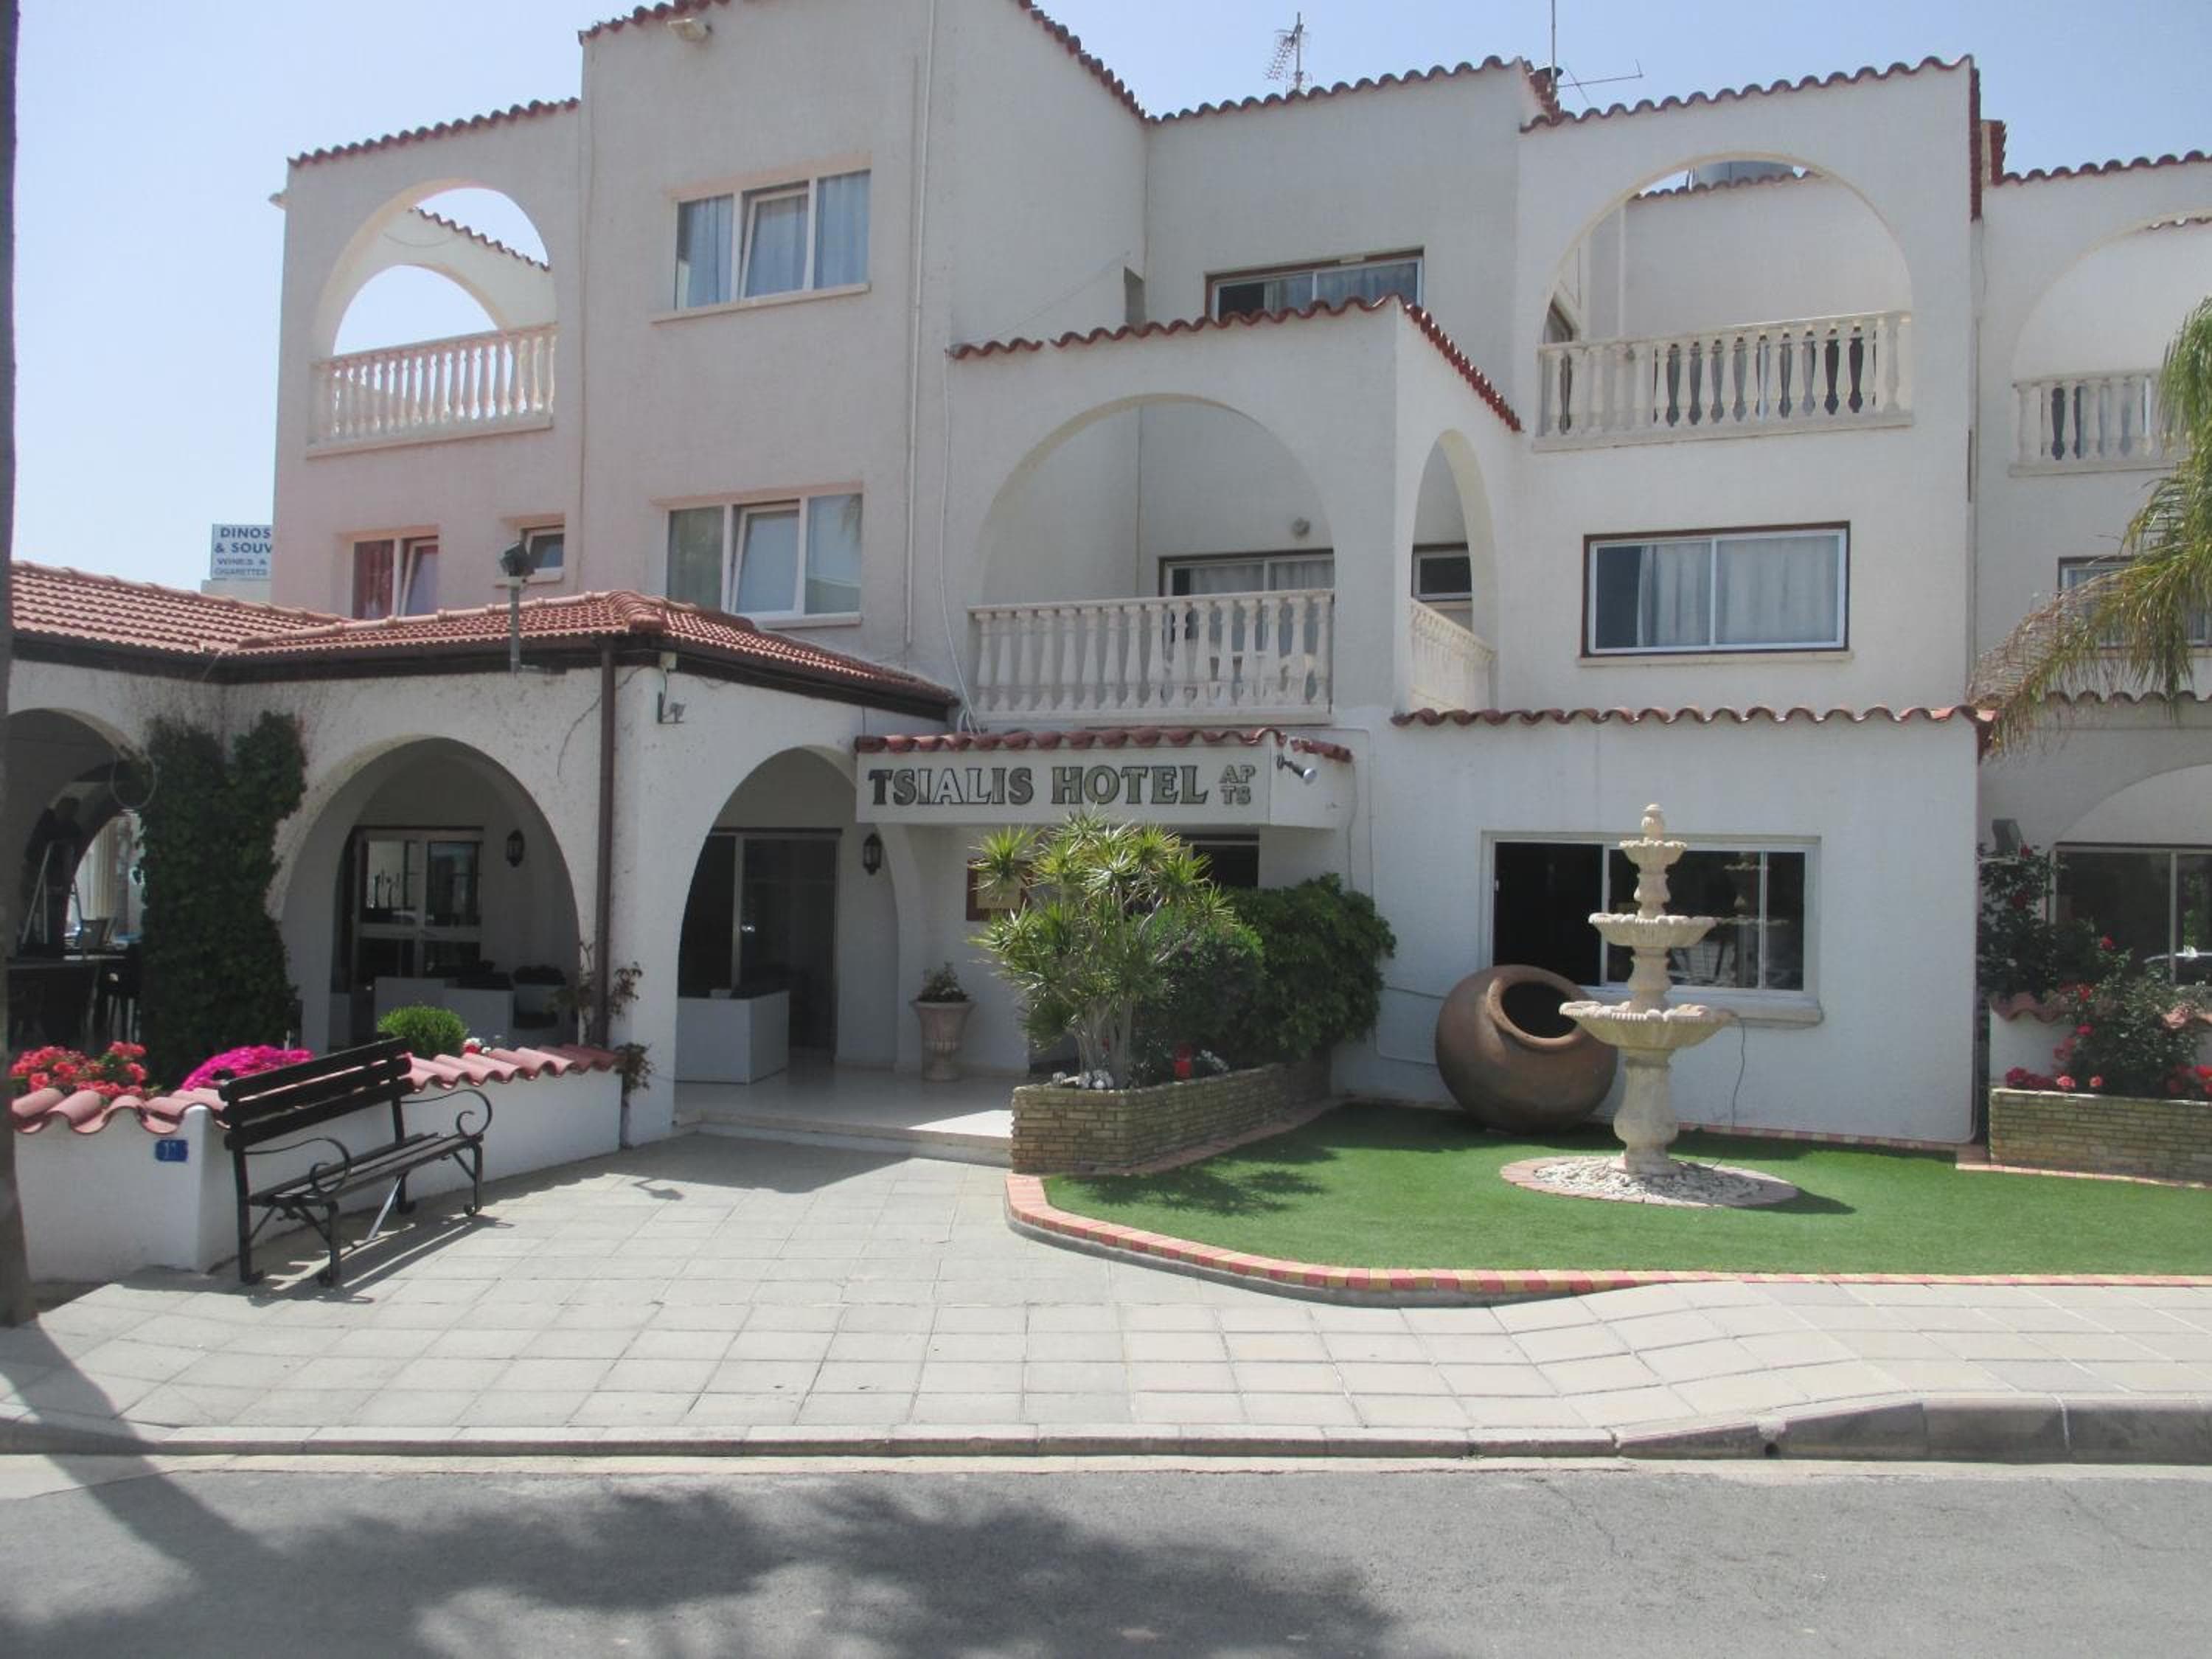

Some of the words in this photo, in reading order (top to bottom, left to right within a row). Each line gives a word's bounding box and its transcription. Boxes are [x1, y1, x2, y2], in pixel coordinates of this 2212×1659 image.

[220, 527, 271, 538] DINOS
[214, 542, 224, 553] &
[1219, 764, 1256, 784] AP
[868, 768, 1034, 806] TSIALIS
[1051, 765, 1208, 804] HOTEL
